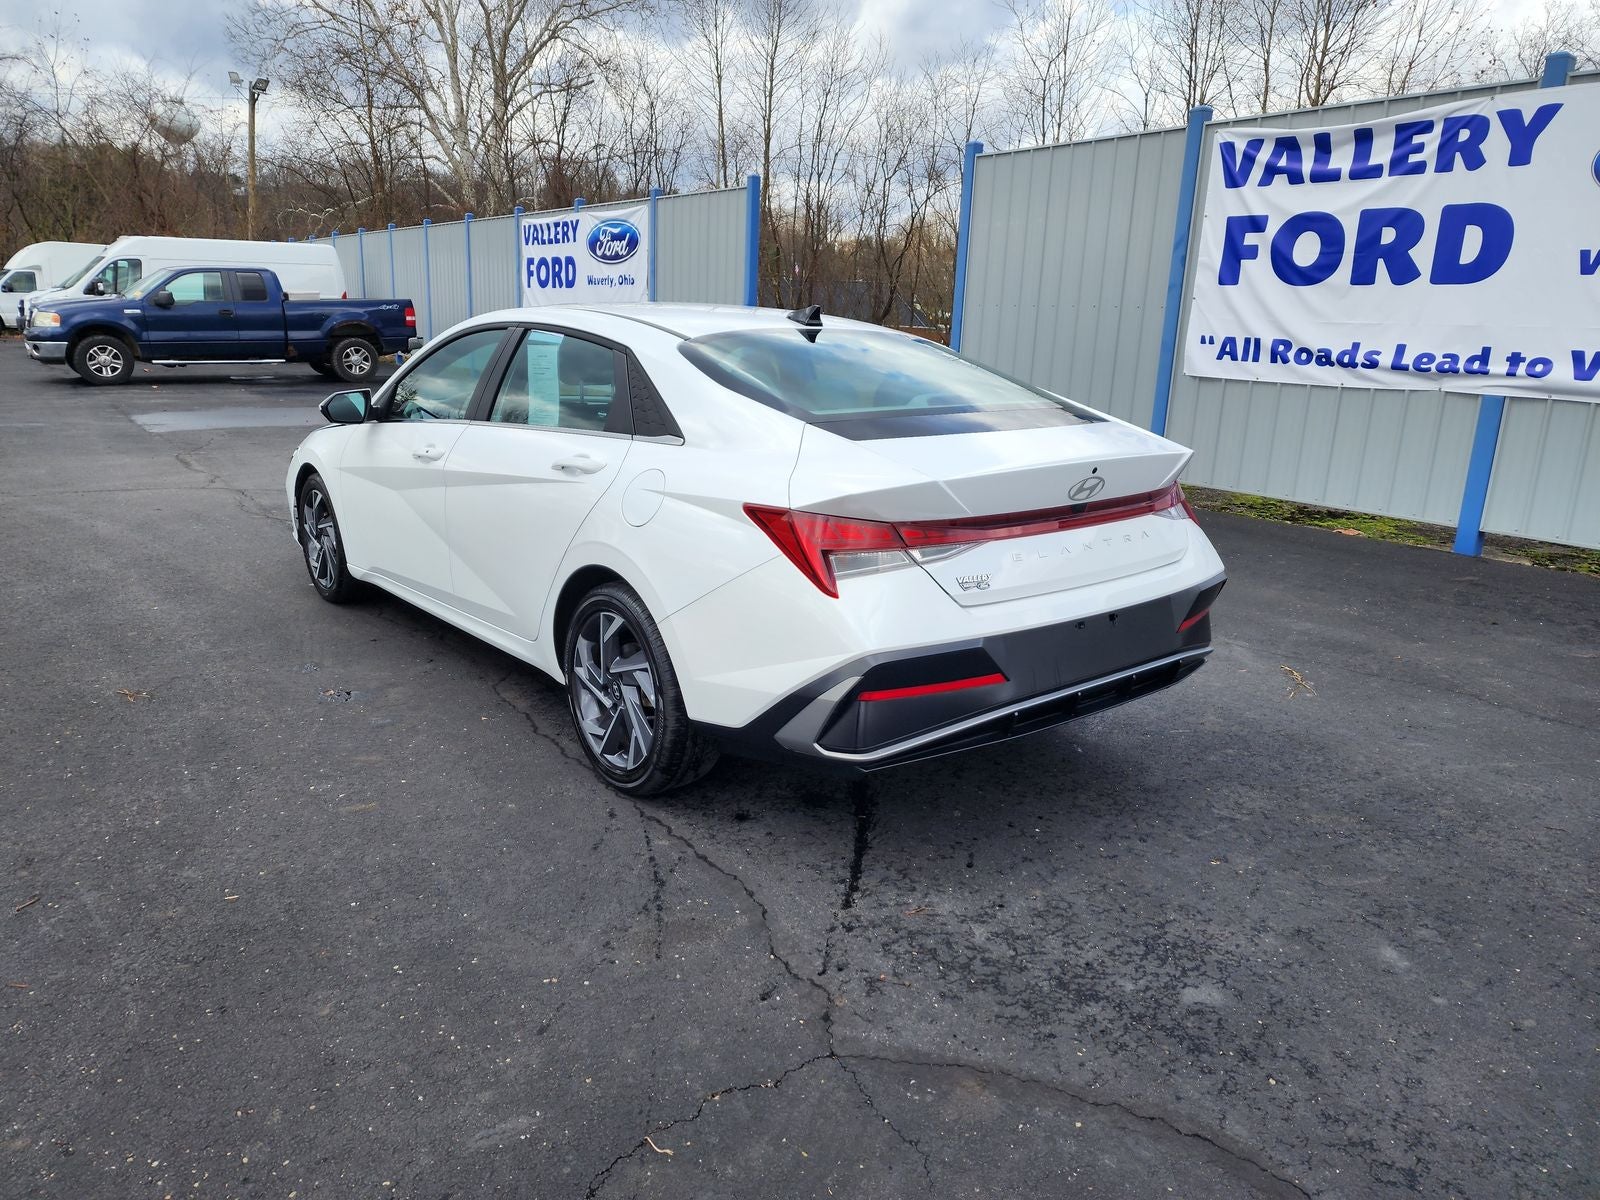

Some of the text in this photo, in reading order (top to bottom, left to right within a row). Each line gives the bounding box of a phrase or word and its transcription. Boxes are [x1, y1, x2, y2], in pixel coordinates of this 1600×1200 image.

[1218, 102, 1564, 189] VALLERY
[523, 219, 580, 246] VALLERY
[596, 226, 629, 257] Ford
[1217, 202, 1515, 287] FORD
[526, 255, 577, 289] FORD
[587, 274, 635, 288] Waverly, Ohio
[1269, 337, 1382, 369] Roads
[1390, 343, 1492, 376] Lead
[1505, 351, 1554, 379] to
[1011, 530, 1151, 562] ELANTRA
